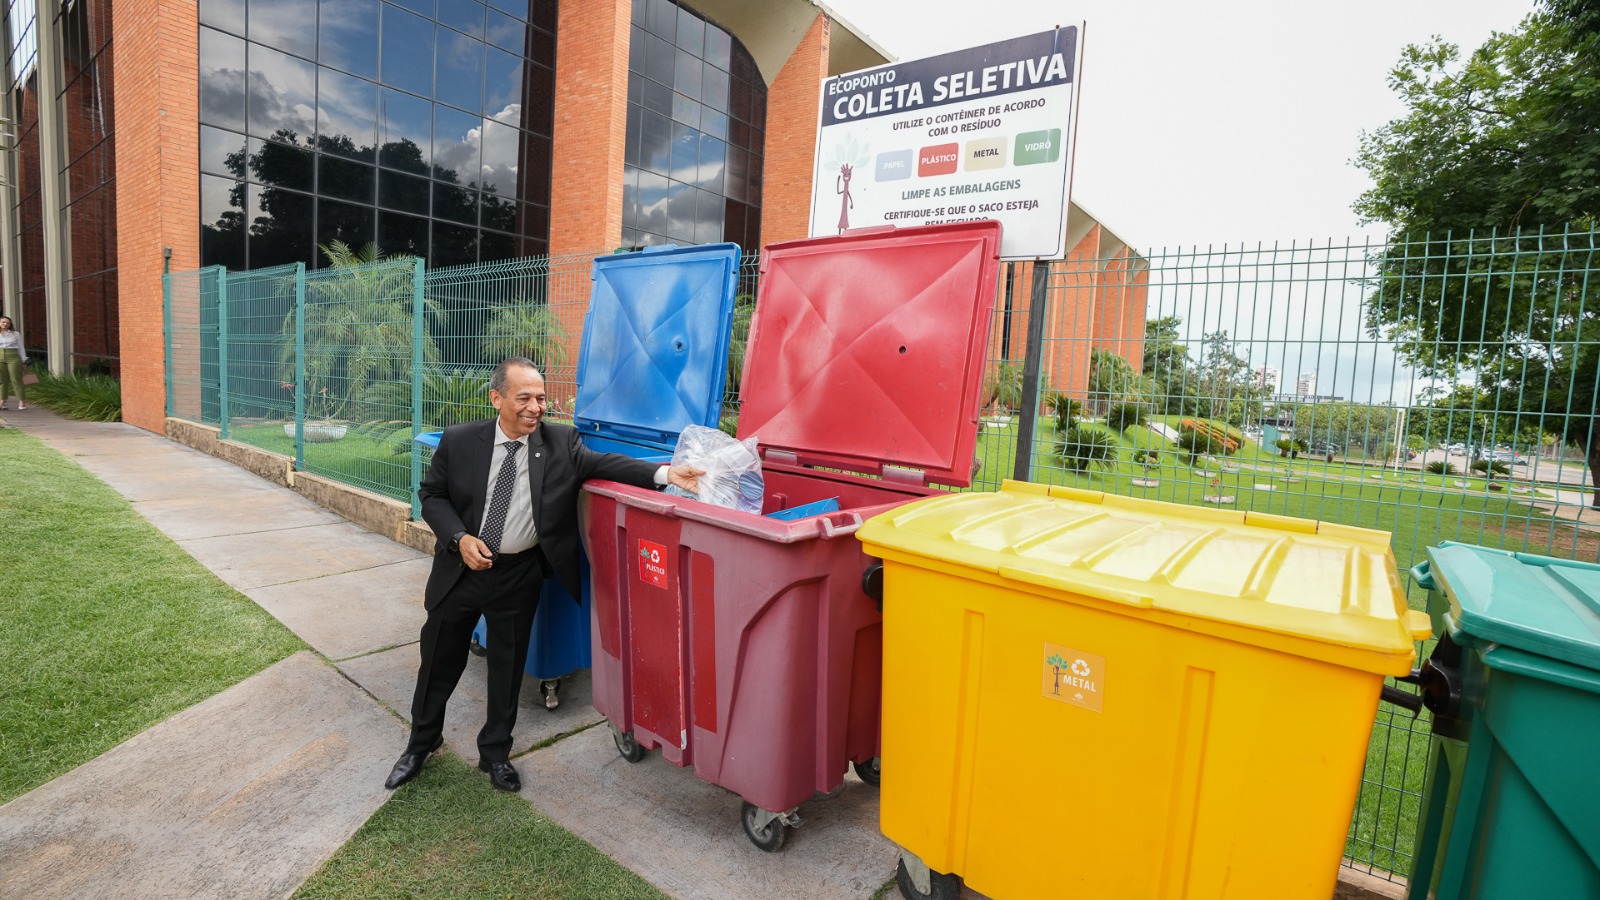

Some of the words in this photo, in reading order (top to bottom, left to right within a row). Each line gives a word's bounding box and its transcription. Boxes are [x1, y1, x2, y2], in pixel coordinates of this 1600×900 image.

[829, 70, 896, 96] ECOPONTO
[834, 81, 924, 120] COLETA
[932, 52, 1067, 102] SELETIVA
[892, 118, 924, 130] UTILIZE
[935, 106, 986, 124] CONTÊINER
[988, 105, 1001, 114] DE
[1003, 98, 1046, 112] ACORDO
[928, 126, 949, 137] COM
[951, 126, 958, 134] O
[960, 118, 1002, 132] RESÍDUO
[974, 148, 999, 158] METAL
[1024, 141, 1052, 152] VIDRO
[884, 160, 904, 170] PAPEL
[922, 154, 957, 165] PLÁSTICO
[901, 189, 931, 200] LIMPE
[933, 187, 946, 197] AS
[950, 179, 1021, 195] EMBALAGENS
[884, 207, 945, 220] CERTIFIQUE-SE
[948, 205, 966, 215] QUE
[969, 205, 976, 213] O
[978, 202, 1003, 213] SACO
[1006, 199, 1039, 211] ESTEJA
[1063, 674, 1096, 692] METAL
